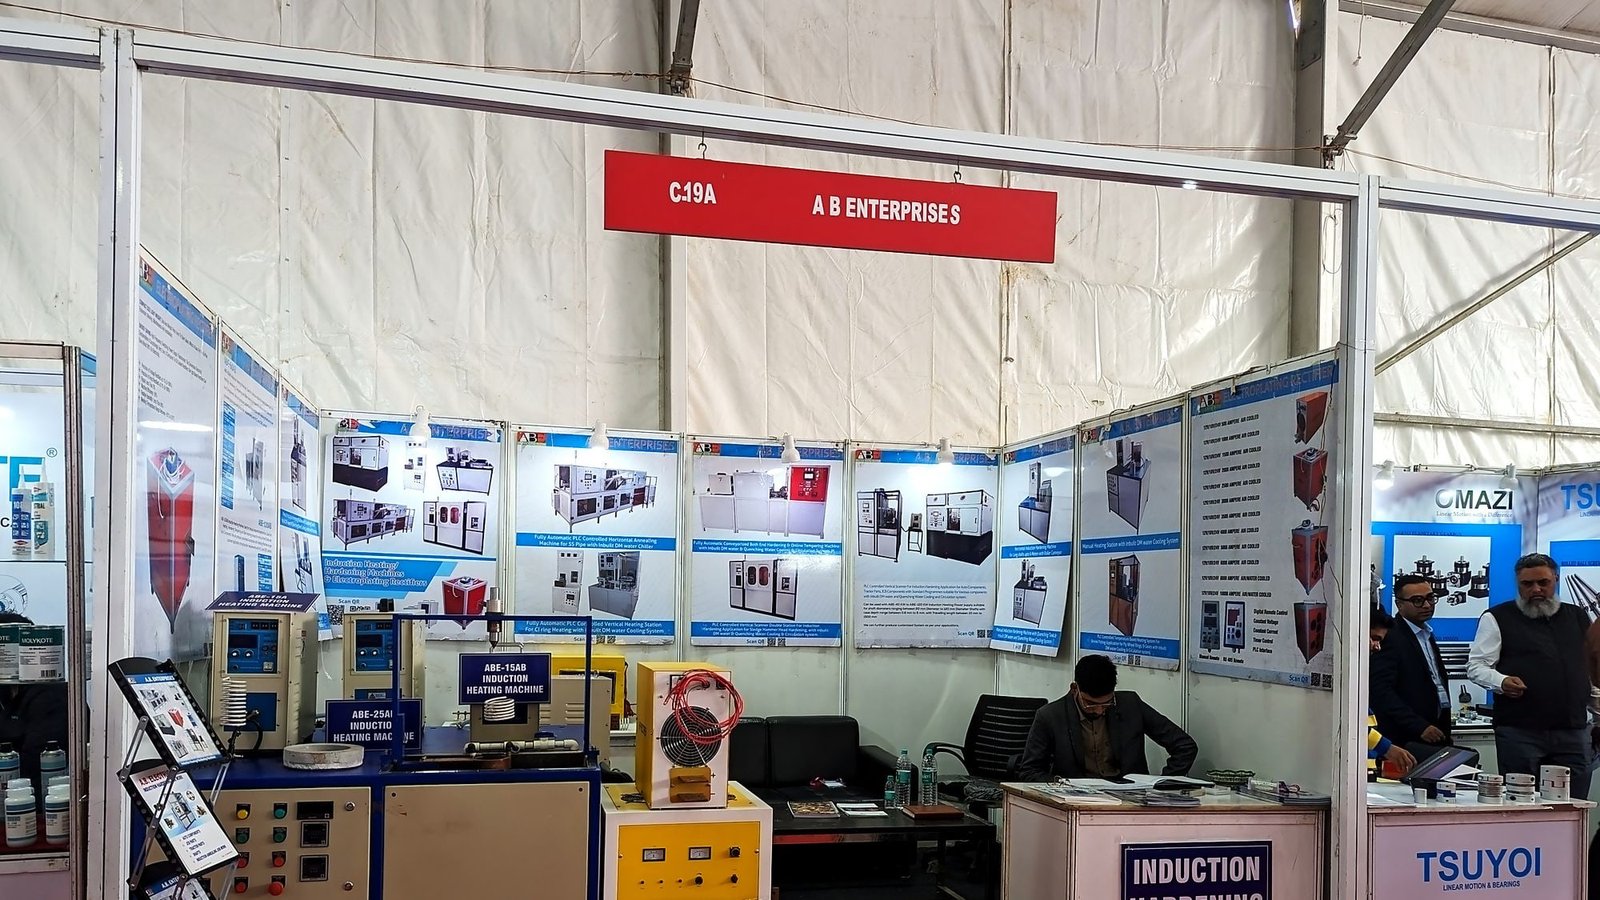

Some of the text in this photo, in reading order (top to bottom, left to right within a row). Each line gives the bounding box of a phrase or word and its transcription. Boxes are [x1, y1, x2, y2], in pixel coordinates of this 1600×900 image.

[812, 194, 960, 225] A B ENTERPRISES
[518, 433, 546, 443] ABE
[694, 443, 720, 454] ABE
[856, 450, 880, 460] ABE
[1435, 489, 1512, 510] OMAZI
[325, 559, 363, 568] Induction
[324, 567, 404, 577] Hardening Machines
[332, 576, 389, 586] Electroplating
[484, 663, 527, 672] ABE-15AB
[482, 674, 528, 683] INDUCTION
[1288, 674, 1301, 683] Scan
[466, 685, 544, 695] HEATING MACHINE
[352, 710, 392, 719] ABE-25A
[350, 721, 392, 730] INDUCTIO
[333, 732, 414, 742] HEATING MACNE
[1416, 847, 1541, 882] TSUYOI
[1133, 856, 1260, 885] INDUCTION
[1442, 883, 1463, 891] LINEAR
